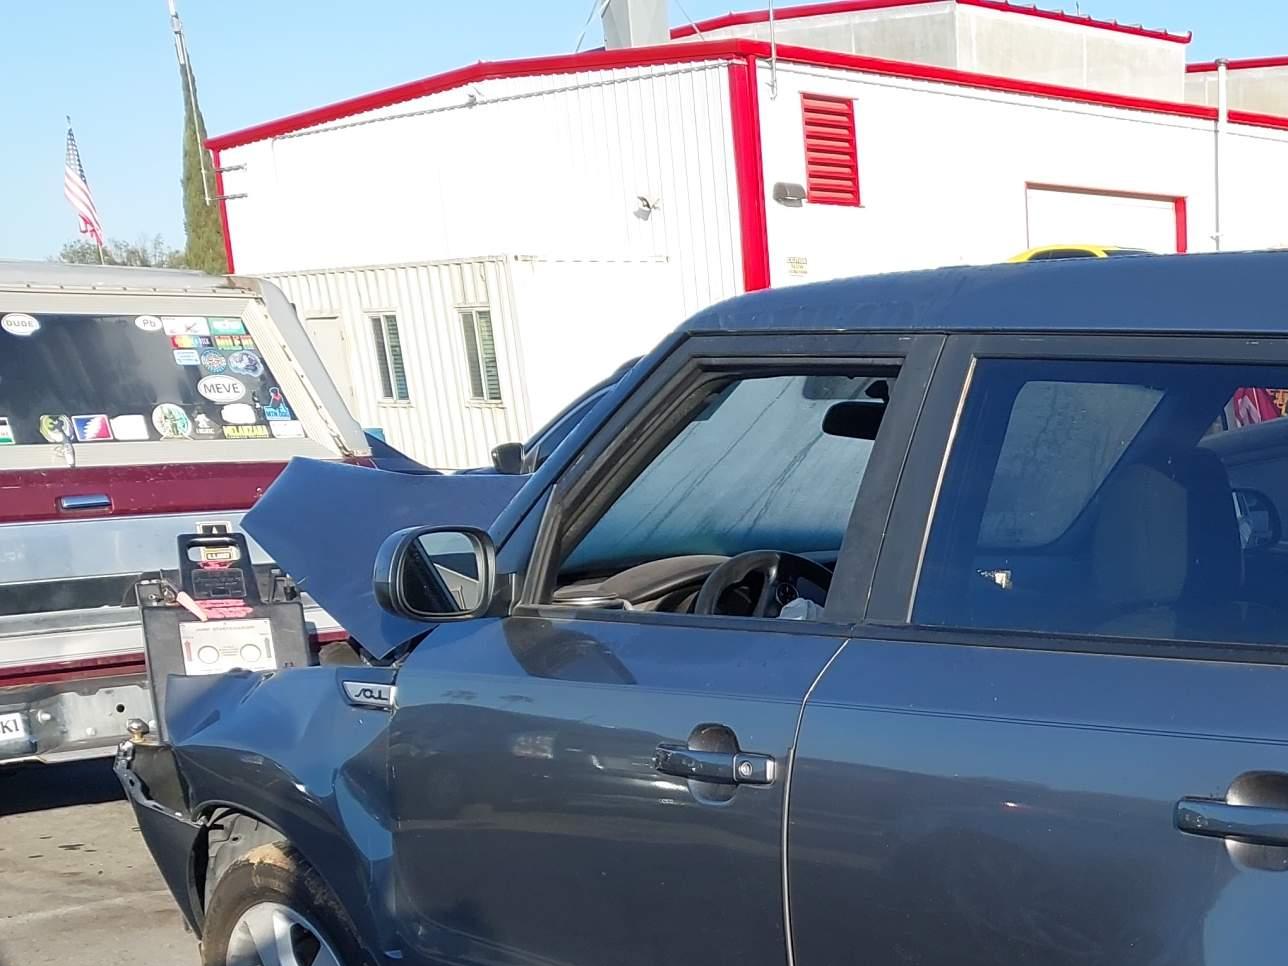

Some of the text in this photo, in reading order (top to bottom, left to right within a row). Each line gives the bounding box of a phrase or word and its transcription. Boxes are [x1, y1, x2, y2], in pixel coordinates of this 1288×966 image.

[5, 320, 34, 328] DUDE
[142, 318, 157, 328] Pb
[203, 383, 241, 394] MEVE
[0, 718, 20, 734] KI
